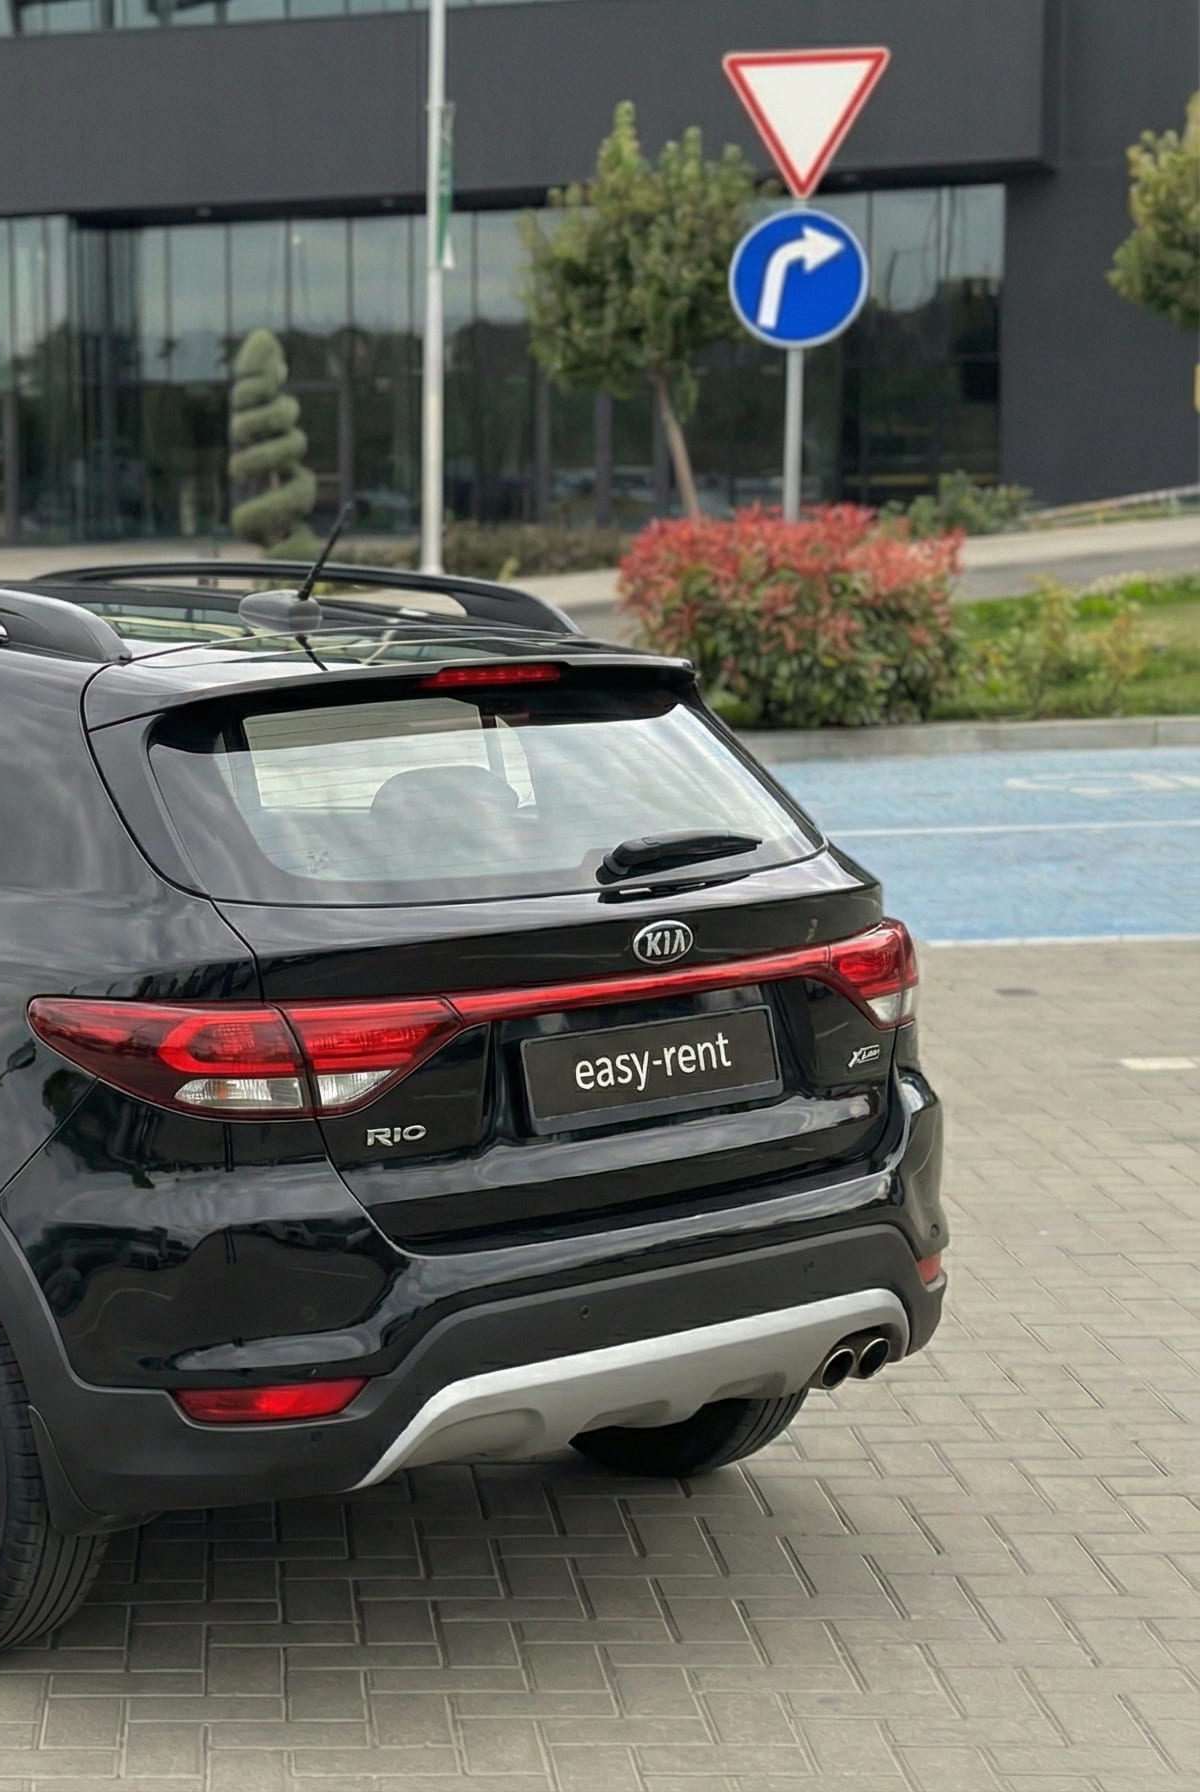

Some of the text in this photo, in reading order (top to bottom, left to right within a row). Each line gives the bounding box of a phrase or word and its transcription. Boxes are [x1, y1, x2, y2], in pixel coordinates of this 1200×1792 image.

[645, 929, 686, 957] KIA
[575, 1032, 732, 1092] easy-rent
[366, 1125, 427, 1147] RIO
